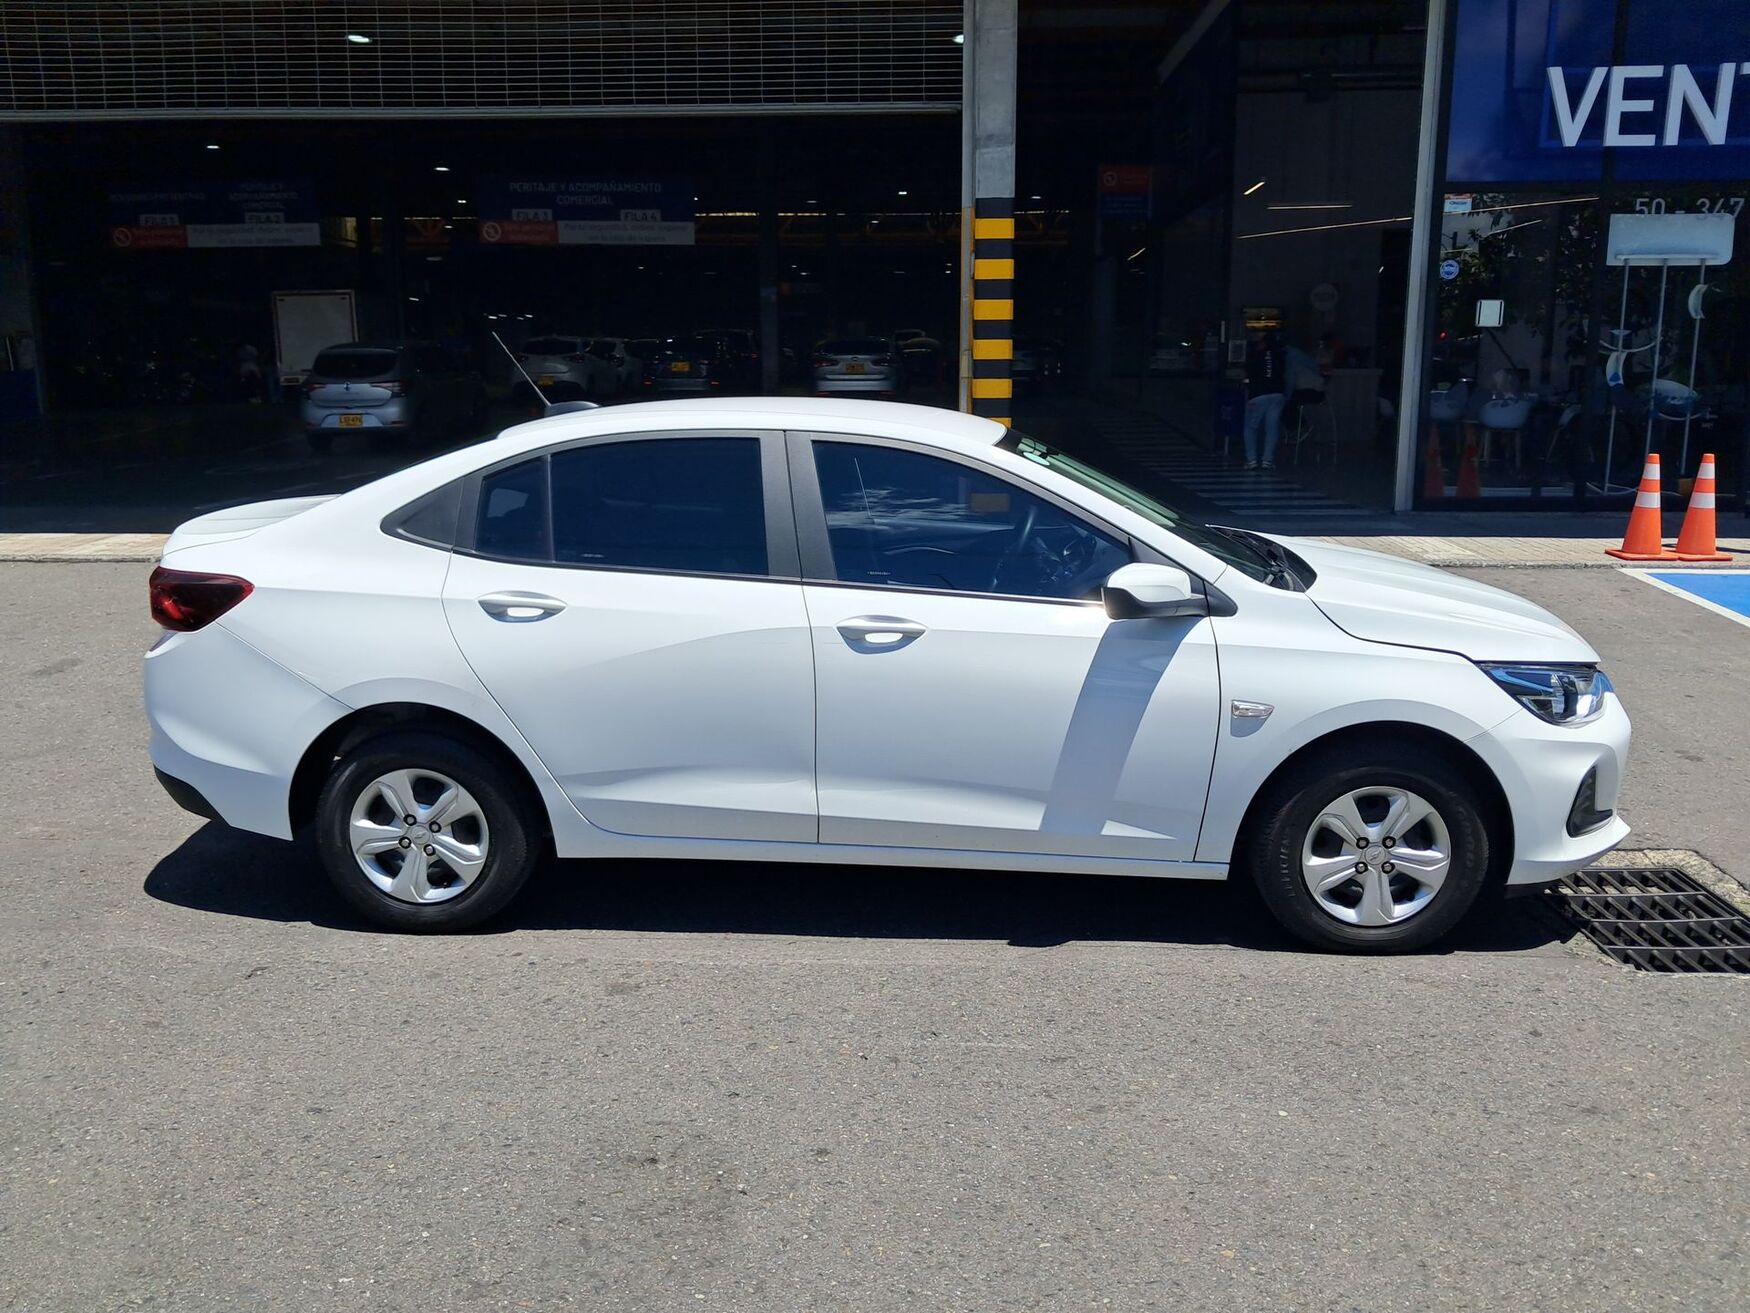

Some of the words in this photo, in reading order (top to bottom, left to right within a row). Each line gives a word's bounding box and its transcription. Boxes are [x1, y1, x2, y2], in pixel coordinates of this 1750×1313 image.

[1547, 62, 1750, 148] VEN
[509, 182, 557, 193] PERITAJE
[556, 195, 614, 206] COMERCIAL
